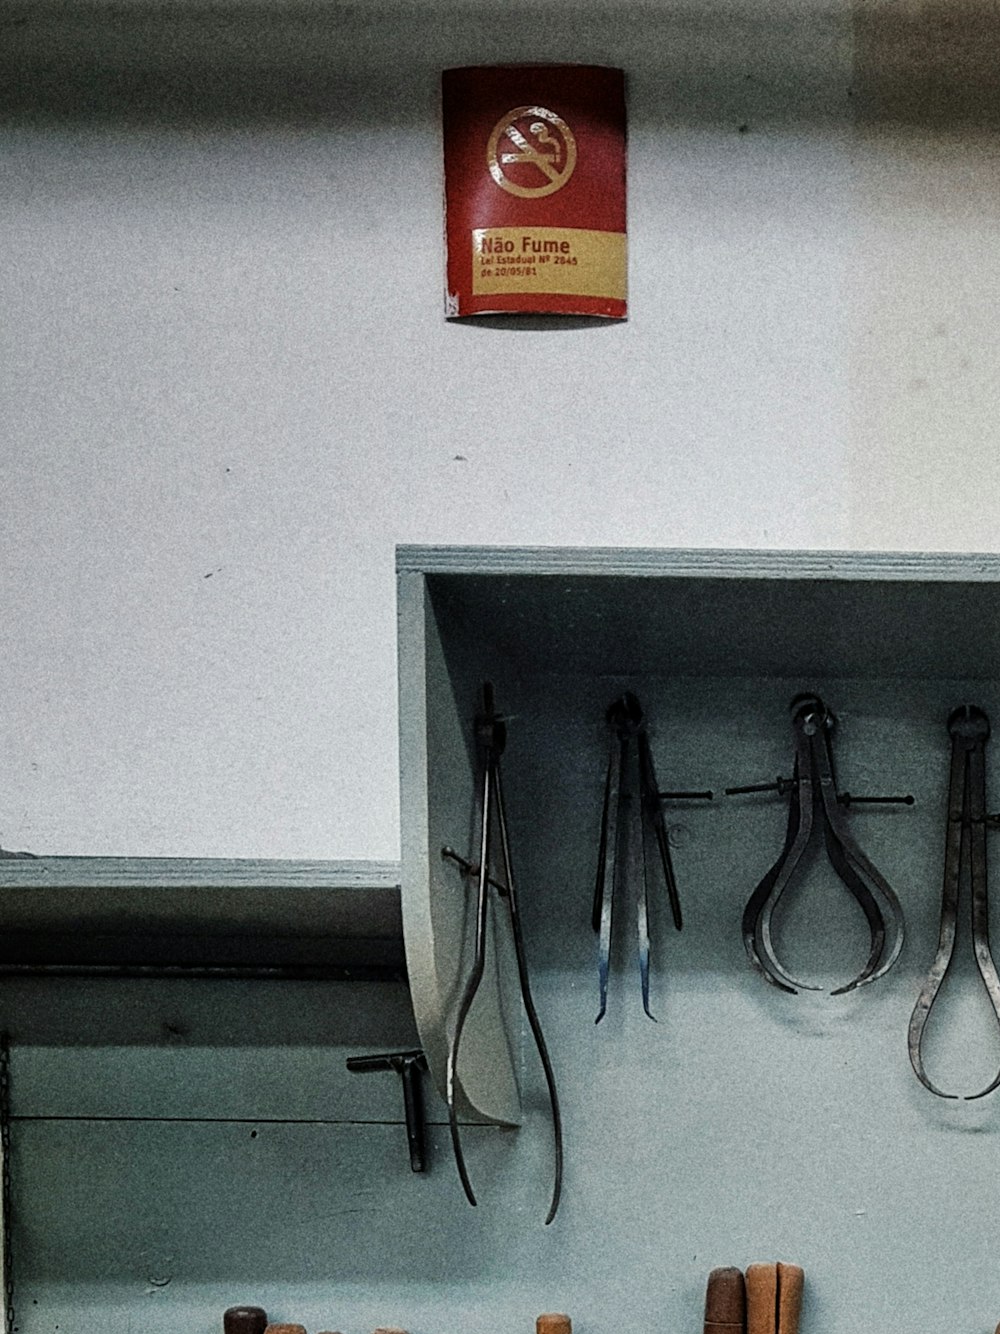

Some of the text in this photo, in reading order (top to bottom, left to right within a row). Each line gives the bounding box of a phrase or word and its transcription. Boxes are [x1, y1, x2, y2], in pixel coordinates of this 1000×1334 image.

[481, 237, 571, 254] Não Fume
[481, 255, 494, 266] Lei
[496, 255, 536, 265] Estadual
[481, 267, 493, 278] de
